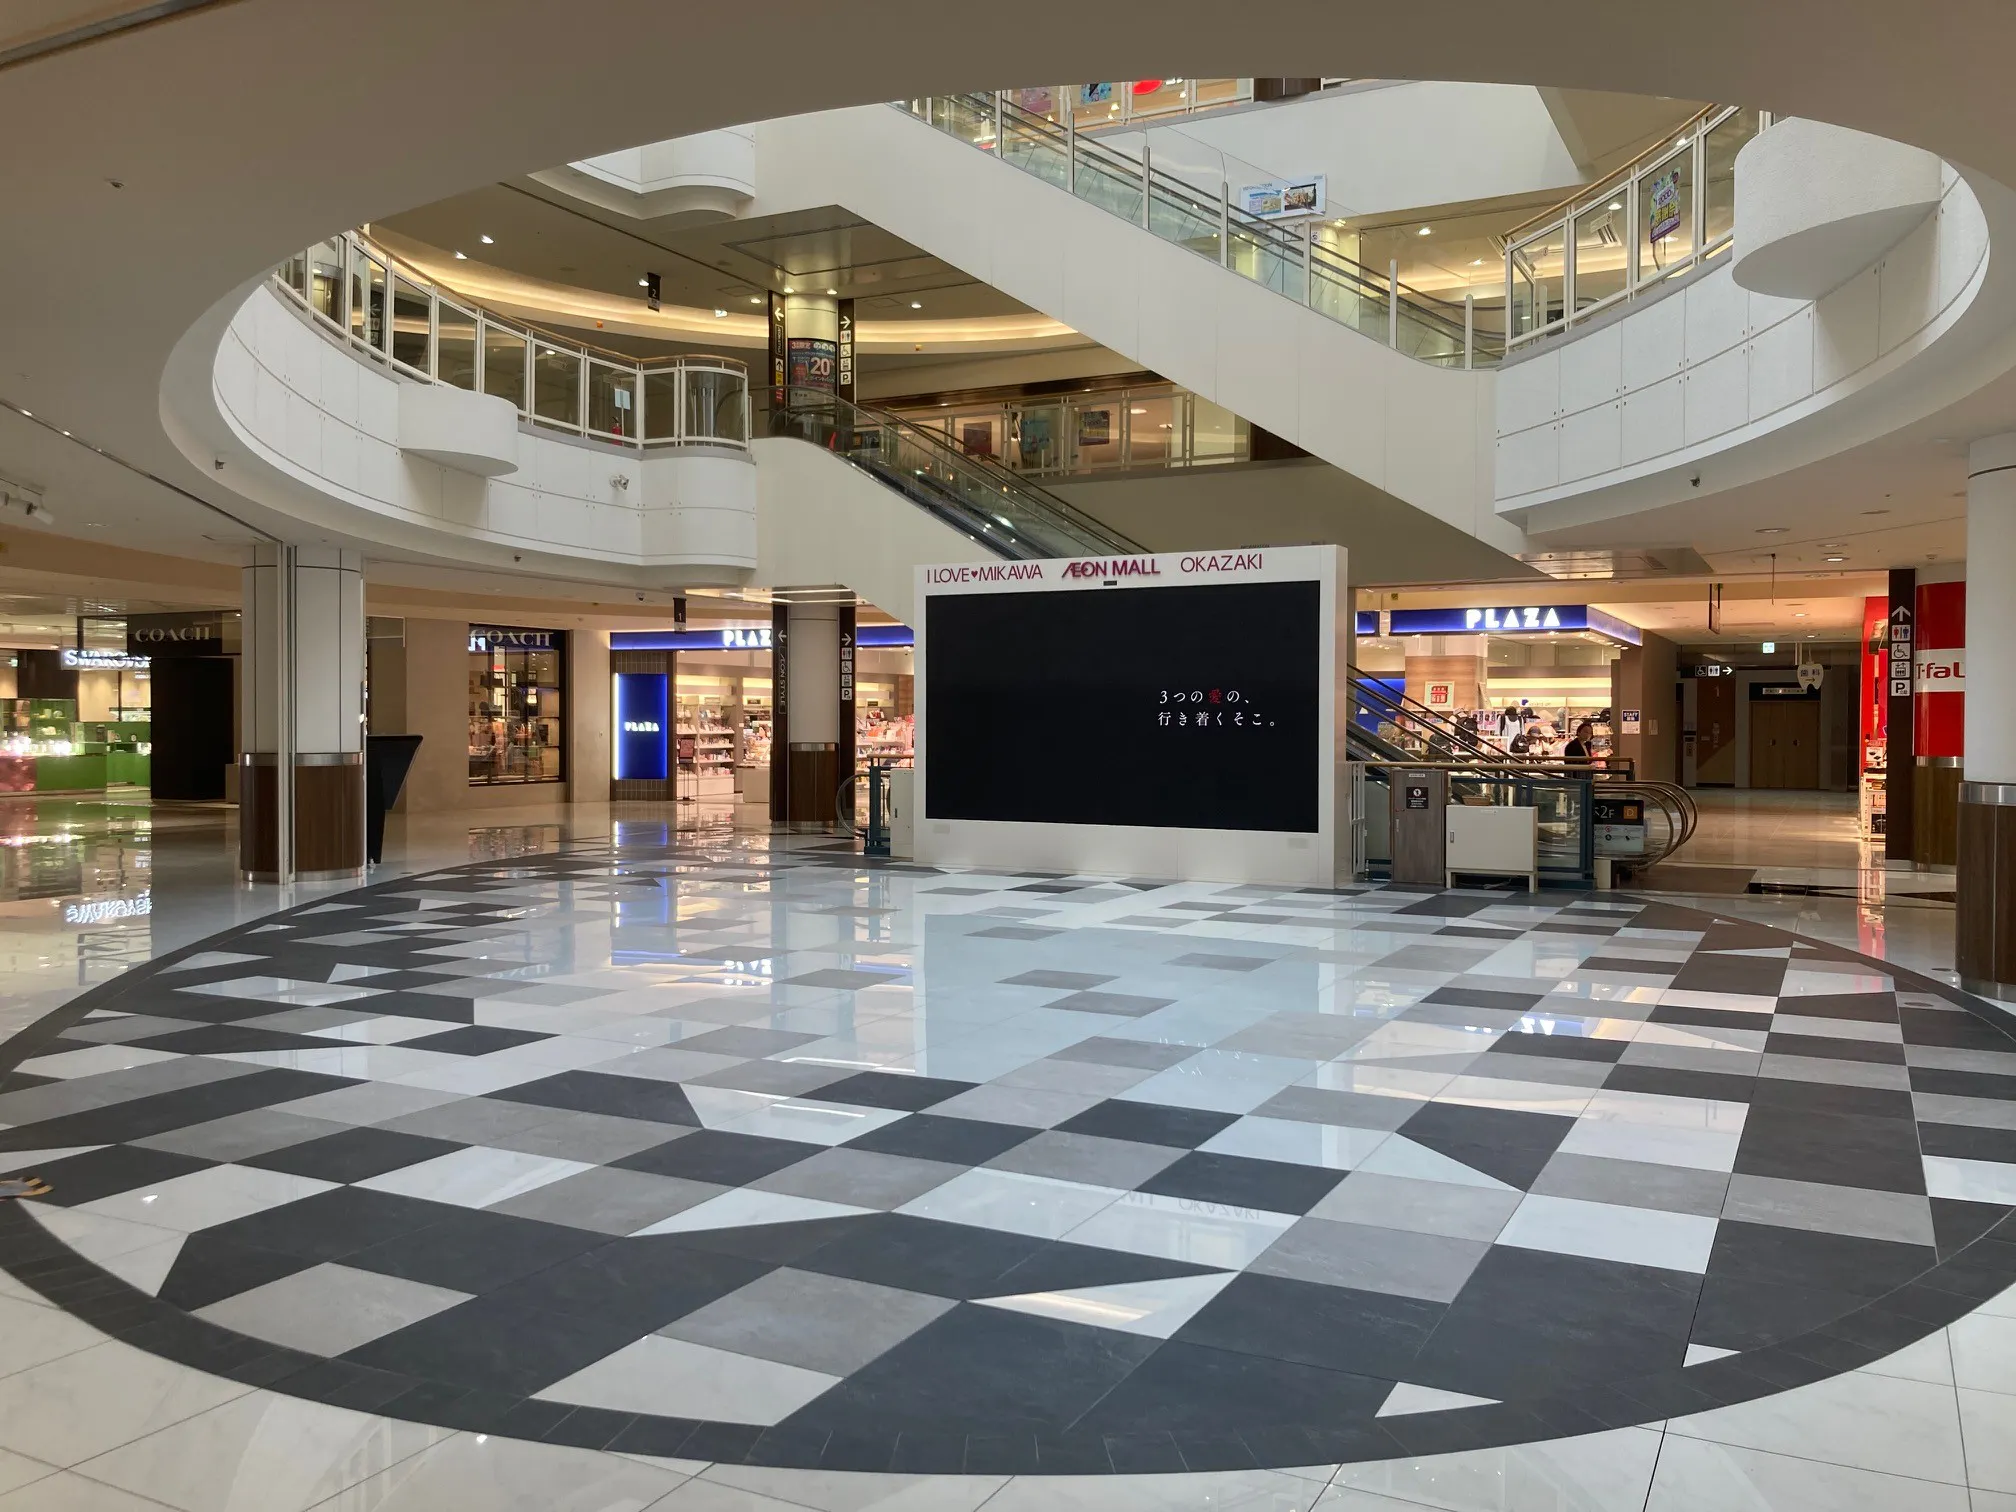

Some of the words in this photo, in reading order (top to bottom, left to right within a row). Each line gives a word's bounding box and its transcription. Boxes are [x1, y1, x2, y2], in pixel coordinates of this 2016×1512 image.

[1112, 558, 1161, 577] MALL
[1180, 553, 1263, 573] OKAZAKI
[926, 569, 931, 583] I
[934, 567, 970, 584] LOVE
[978, 564, 1043, 582] MIKAWA
[1466, 607, 1561, 629] PLAZA
[134, 626, 210, 643] COACH
[470, 628, 551, 647] COACH
[1159, 688, 1249, 704] 3つの愛の、
[623, 721, 660, 732] PLAZA
[1158, 711, 1275, 726] 行き着くそこ。
[1599, 805, 1615, 819] 2F
